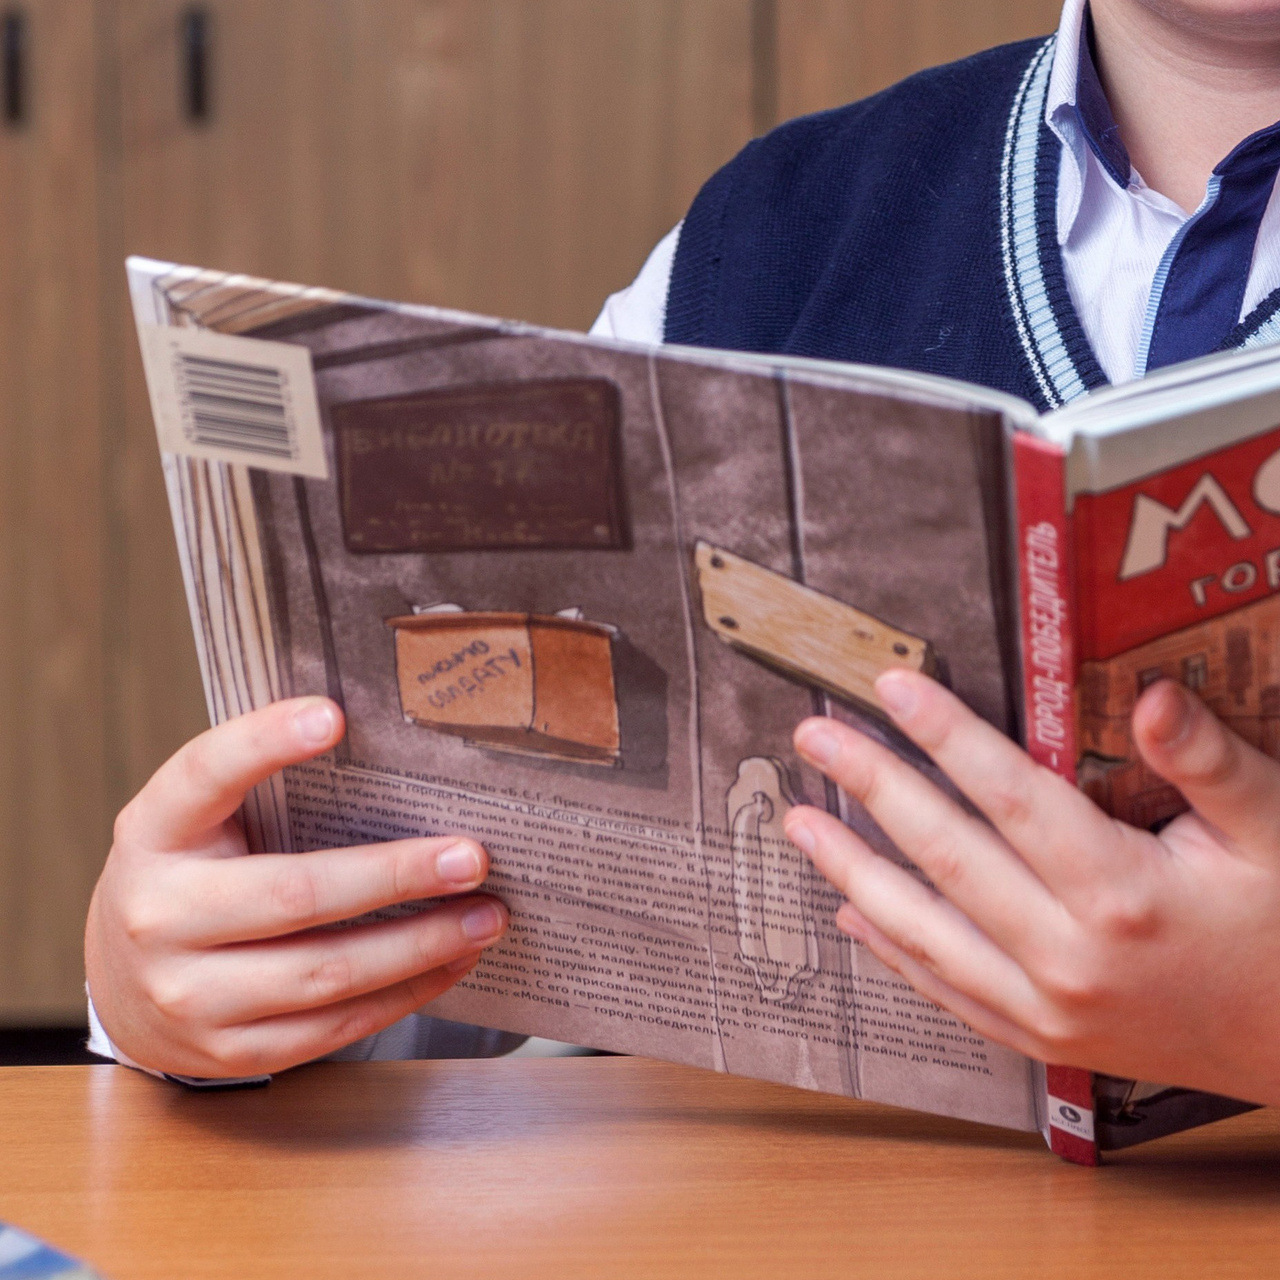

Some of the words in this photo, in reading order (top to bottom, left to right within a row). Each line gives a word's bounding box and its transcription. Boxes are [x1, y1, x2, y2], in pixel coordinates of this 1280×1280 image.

[1026, 521, 1069, 751] ГОРОД-ПОБЕДИТЕЛЬ
[284, 776, 300, 786] на
[345, 787, 377, 800] «Как
[381, 794, 442, 812] говорить
[447, 806, 453, 814] с
[458, 808, 506, 824] детьми
[510, 818, 518, 826] о
[582, 829, 590, 839] В
[595, 833, 666, 854] дискуссии
[671, 848, 730, 865] приняли
[735, 859, 788, 876] участие
[794, 870, 826, 883] преп
[286, 791, 361, 812] психологи,
[365, 805, 427, 823] издатели
[431, 817, 438, 825] и
[443, 819, 533, 843] специалисты
[537, 837, 554, 847] по
[558, 841, 621, 861] детскому
[626, 853, 681, 870] чтению.
[686, 862, 695, 873] В
[699, 867, 773, 887] результате
[342, 772, 400, 790] рекламы
[406, 784, 452, 799] города
[515, 804, 522, 812] и
[527, 804, 578, 823] Клубом
[583, 817, 645, 835] учителей
[651, 829, 695, 844] газеты
[370, 764, 399, 776] года
[404, 770, 495, 793] издательство
[606, 807, 680, 827] совместно
[695, 821, 797, 849] Департаменто
[289, 806, 356, 826] критерии,
[361, 818, 419, 836] которым
[597, 862, 654, 879] издание
[658, 873, 666, 881] о
[671, 875, 712, 890] войне
[716, 884, 740, 895] для
[745, 889, 784, 903] детей
[490, 856, 542, 872] должна
[546, 864, 579, 879] быть
[583, 873, 694, 900] познавательной
[699, 895, 706, 903] и
[521, 874, 530, 884] В
[534, 878, 582, 894] основе
[586, 888, 647, 906] рассказа
[651, 900, 703, 916] должна
[507, 909, 551, 924] осква
[576, 922, 708, 953] город-победитель»
[866, 976, 915, 992] москов
[543, 894, 550, 902] в
[555, 896, 614, 914] контекст
[619, 908, 698, 929] глобальных
[477, 957, 529, 974] писано,
[533, 968, 549, 977] но
[554, 971, 561, 979] и
[566, 974, 649, 997] нарисовано,
[654, 990, 717, 1009] показано
[722, 1003, 737, 1013] на
[741, 1005, 835, 1032] фотографиях.
[841, 1023, 867, 1038] При
[872, 1032, 903, 1044] этом
[908, 1039, 946, 1052] книга
[971, 1050, 987, 1060] не
[497, 948, 540, 962] жизни
[545, 956, 611, 976] нарушила
[616, 970, 623, 978] и
[629, 972, 702, 993] разрушила
[706, 987, 753, 1002] война?
[848, 1014, 855, 1022] и
[860, 1016, 918, 1035] машины,
[923, 1028, 931, 1036] и
[936, 1031, 984, 1046] многое
[506, 923, 538, 935] дим
[542, 929, 576, 944] нашу
[581, 936, 639, 954] столицу.
[645, 946, 689, 963] Только
[694, 958, 710, 967] не
[818, 981, 825, 989] а
[829, 983, 887, 1002] давнюю,
[892, 995, 947, 1012] военну
[509, 936, 517, 944] и
[521, 936, 584, 958] большие,
[588, 951, 595, 959] и
[601, 953, 679, 975] маленькие?
[684, 967, 725, 984] Какие
[801, 992, 816, 1001] их
[820, 995, 890, 1016] окружали,
[895, 1009, 911, 1019] на
[916, 1013, 956, 1028] каком
[512, 990, 570, 1008] «Москва
[475, 970, 531, 987] рассказ.
[535, 979, 543, 989] С
[547, 983, 569, 994] его
[573, 988, 619, 1004] героем
[624, 998, 643, 1008] мы
[647, 1002, 706, 1020] пройдем
[710, 1014, 739, 1027] путь
[745, 1021, 757, 1030] от
[762, 1024, 808, 1040] самого
[813, 1034, 859, 1050] начала
[864, 1044, 906, 1058] войны
[911, 1053, 927, 1063] до
[932, 1057, 992, 1076] момента,
